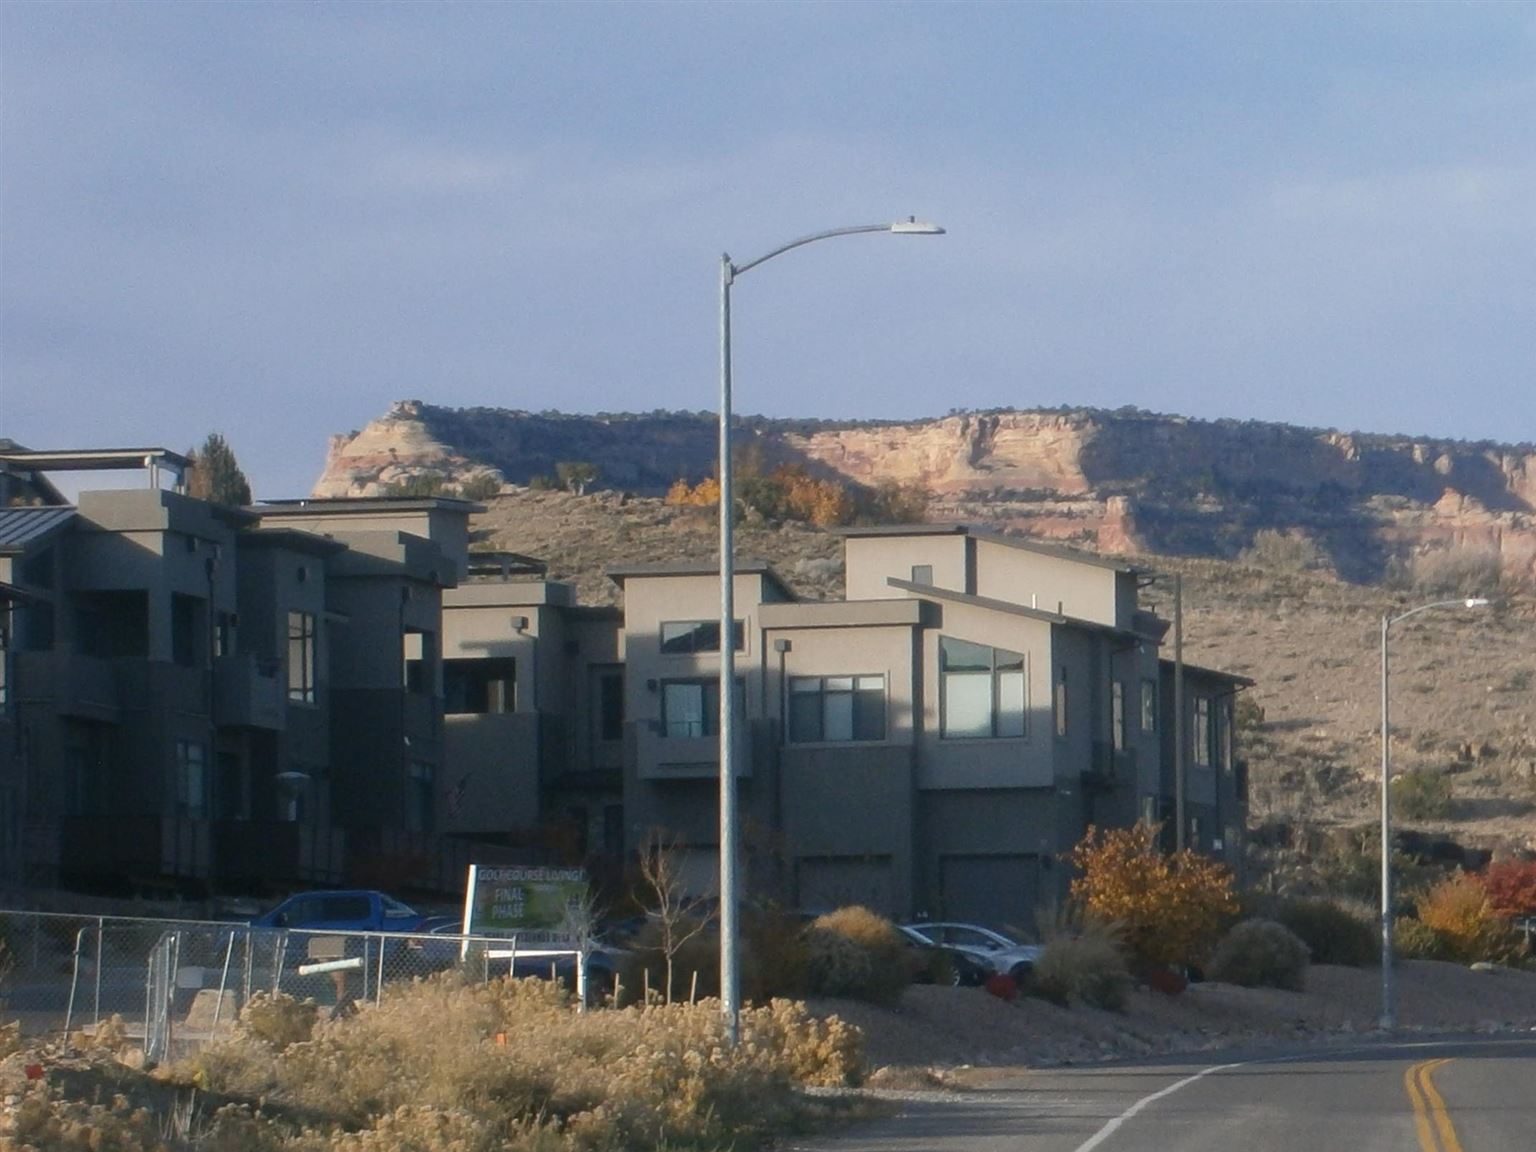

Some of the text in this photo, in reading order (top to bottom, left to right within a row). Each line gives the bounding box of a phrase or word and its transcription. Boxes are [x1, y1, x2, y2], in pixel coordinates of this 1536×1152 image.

[506, 868, 544, 881] COURSE
[495, 887, 524, 901] FINAL
[492, 904, 524, 920] PHASE
